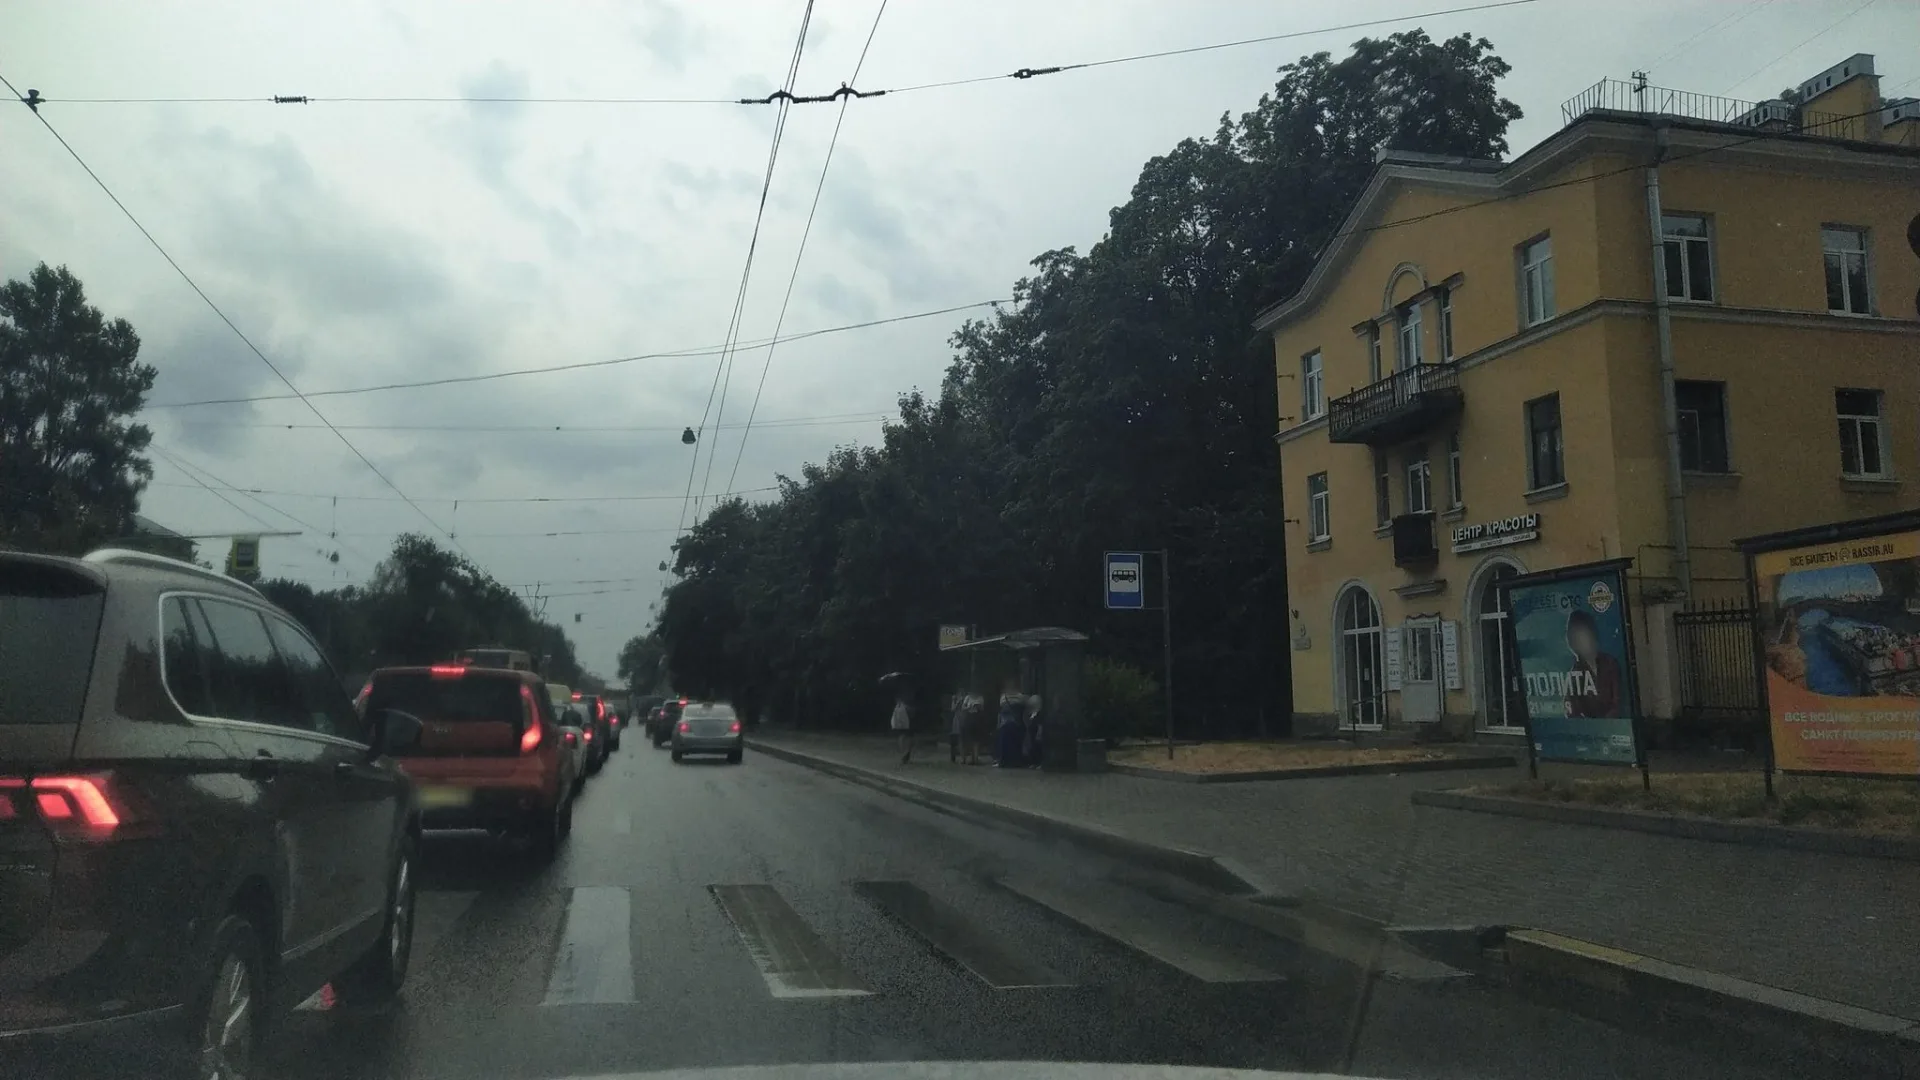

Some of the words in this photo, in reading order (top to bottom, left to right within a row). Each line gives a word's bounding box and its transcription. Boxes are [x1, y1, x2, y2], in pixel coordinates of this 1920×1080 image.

[1451, 524, 1482, 544] ЦЕНТР
[1486, 513, 1537, 536] КРАСОТЫ
[1805, 551, 1838, 565] БИЛЕТЫ
[1525, 670, 1598, 697] ЛОЛИТА
[1784, 711, 1807, 722] ВСЕ
